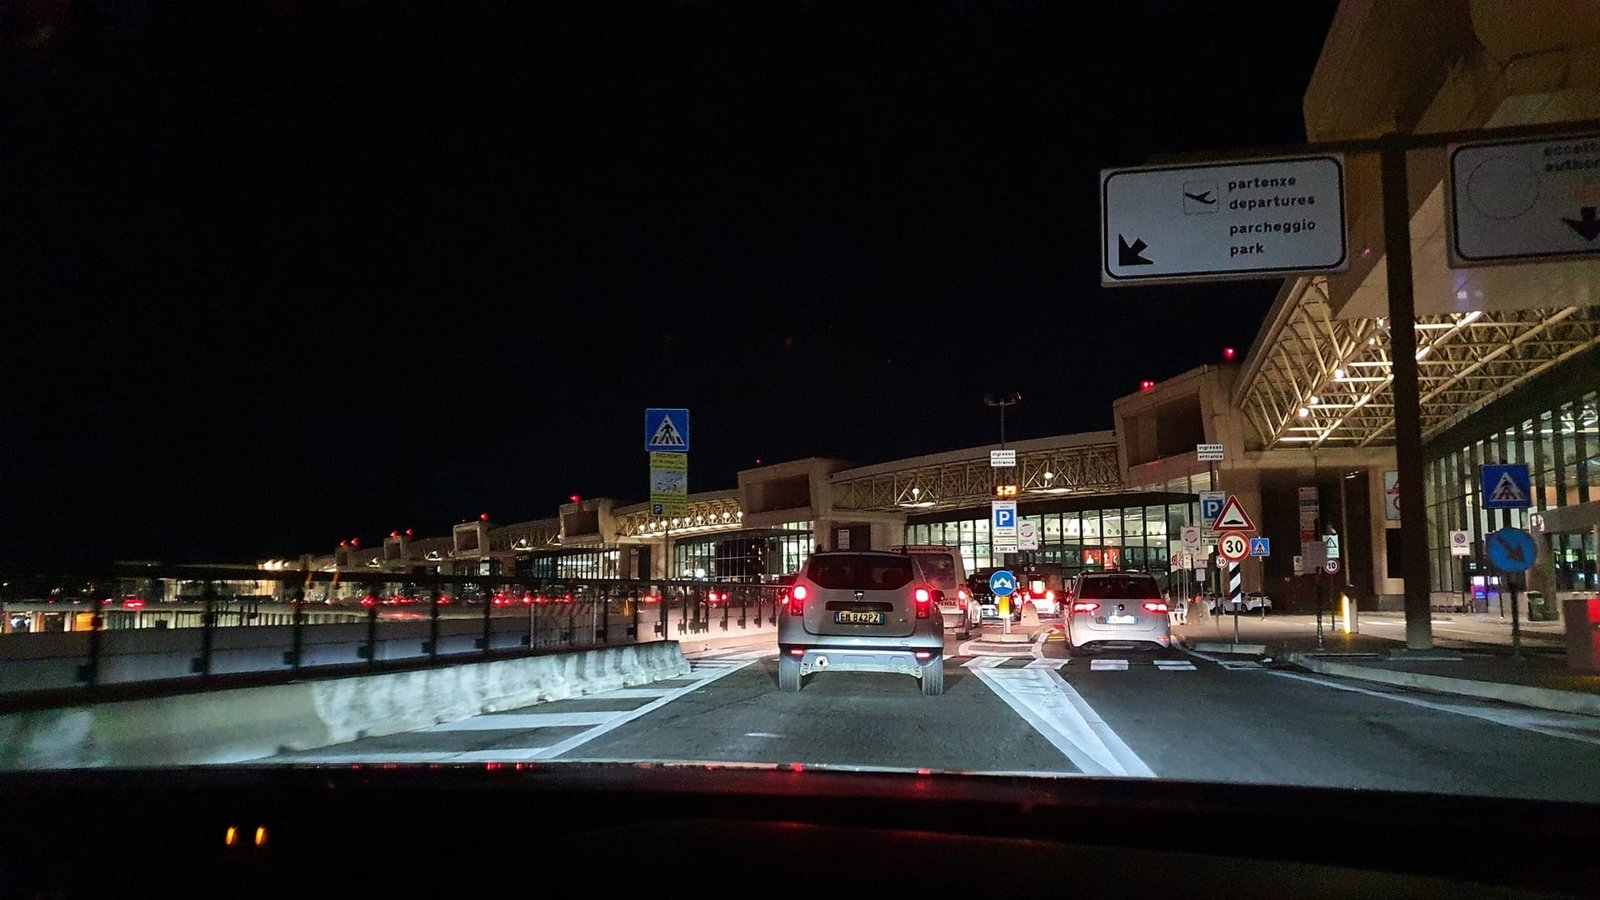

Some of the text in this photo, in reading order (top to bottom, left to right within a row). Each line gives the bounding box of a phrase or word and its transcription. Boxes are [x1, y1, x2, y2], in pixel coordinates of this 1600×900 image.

[1228, 177, 1296, 192] partenze
[1229, 195, 1315, 210] departures
[1229, 219, 1316, 236] parcheggio
[1230, 243, 1264, 257] park
[1207, 501, 1219, 517] P
[999, 511, 1010, 526] P
[1225, 540, 1243, 553] 30
[841, 613, 879, 623] EM 842PZ
